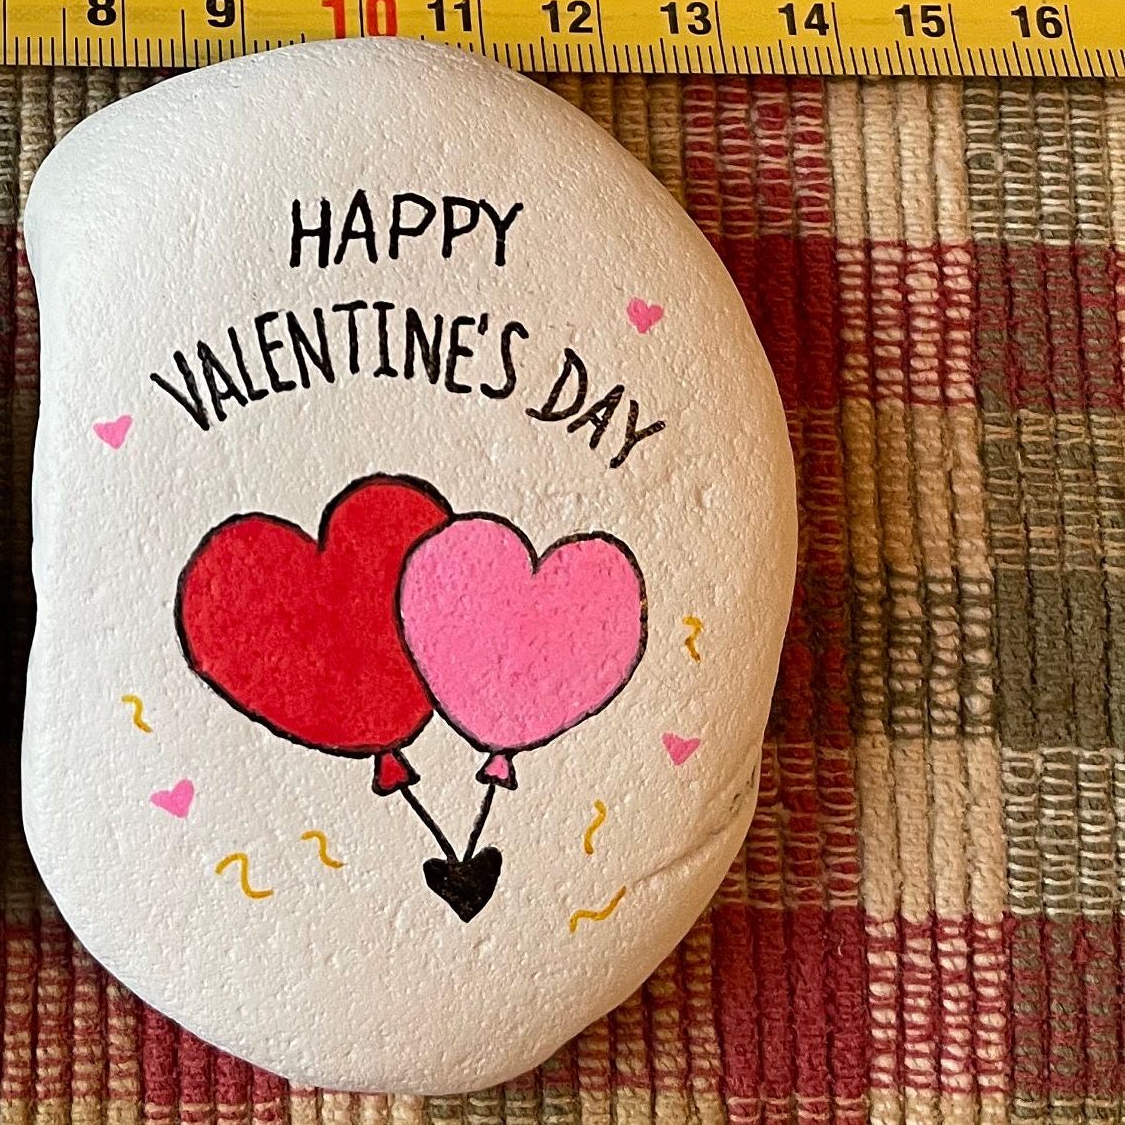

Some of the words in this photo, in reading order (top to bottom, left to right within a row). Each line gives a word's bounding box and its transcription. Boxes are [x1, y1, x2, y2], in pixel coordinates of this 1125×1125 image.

[541, 0, 594, 35] 12
[660, 0, 712, 36] 13
[777, 2, 830, 37] 14
[894, 4, 947, 38] 15
[1011, 5, 1064, 40] 16
[289, 188, 523, 267] HAPPY
[150, 300, 530, 431] VALENTINE'S
[525, 348, 664, 469] DAY
